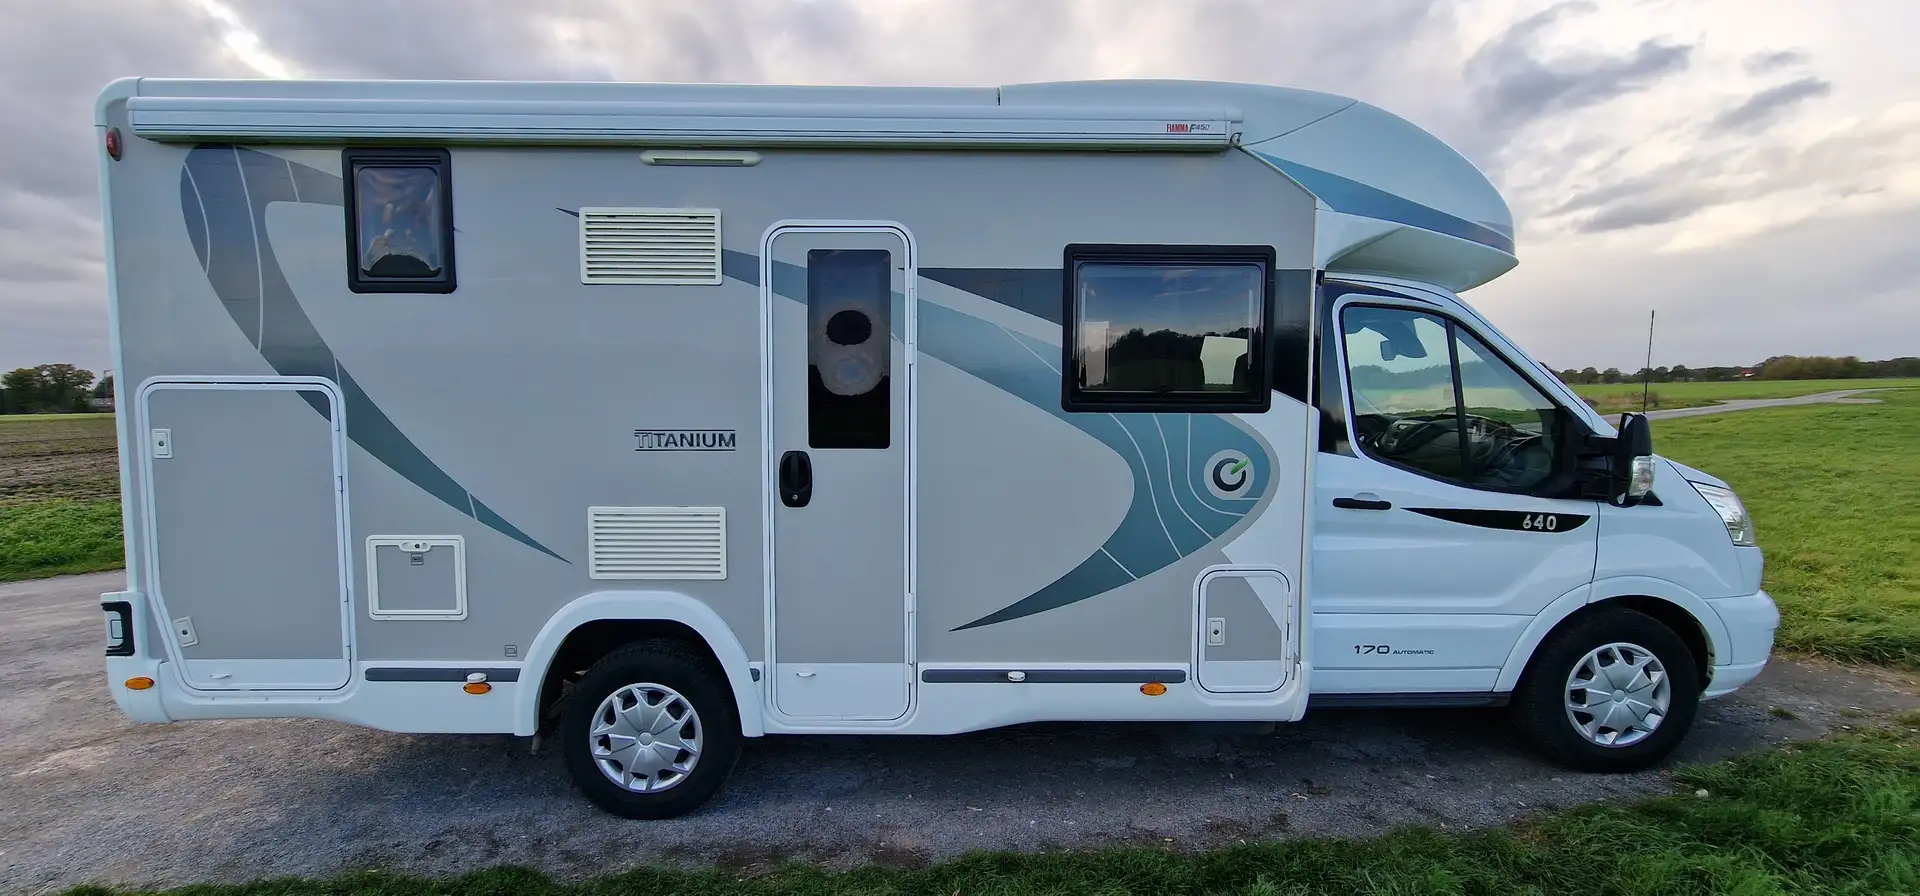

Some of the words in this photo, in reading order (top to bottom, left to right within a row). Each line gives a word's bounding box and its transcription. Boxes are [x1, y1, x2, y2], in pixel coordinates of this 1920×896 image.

[1166, 123, 1188, 132] FIAMMA
[634, 432, 736, 448] TITANIUM
[1522, 514, 1557, 530] 640
[1354, 645, 1390, 655] 170
